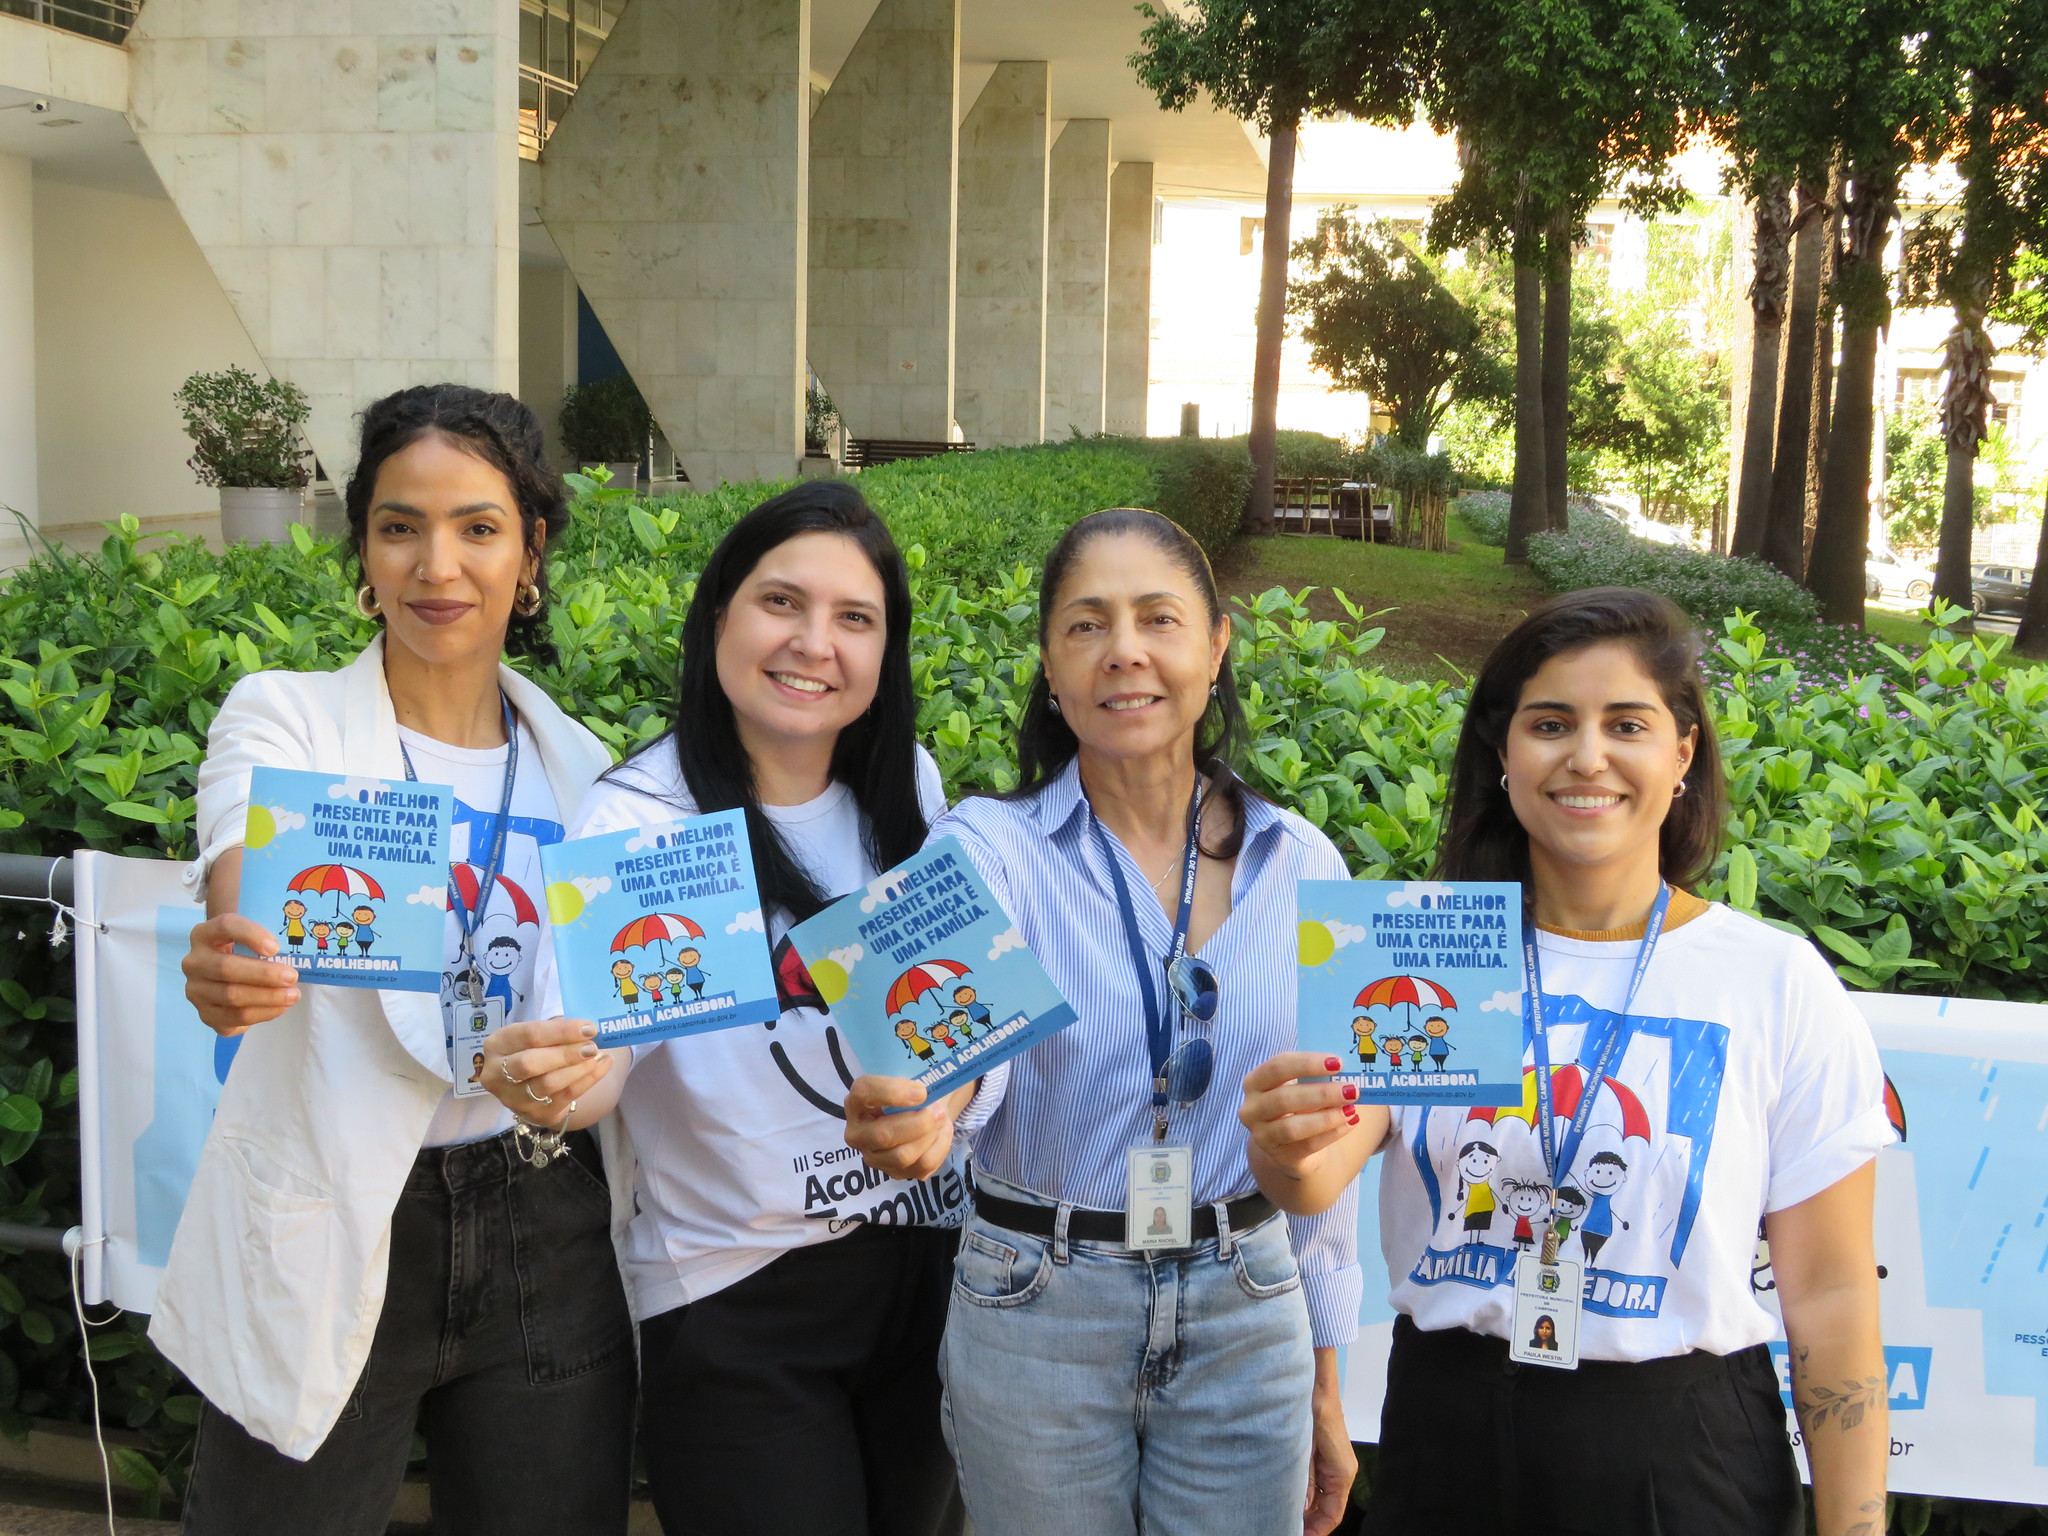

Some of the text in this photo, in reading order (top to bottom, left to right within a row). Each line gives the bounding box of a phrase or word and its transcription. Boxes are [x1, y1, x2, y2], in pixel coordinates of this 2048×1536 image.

[358, 789, 440, 810] O MELHOR
[312, 803, 438, 829] PRESENTE PARA
[314, 822, 438, 846] UMA CRIANÇA É
[656, 822, 734, 850] O MELHOR
[328, 842, 436, 865] UMA FAMÍLIA.
[615, 840, 738, 876] PRESENTE PARA
[1188, 860, 1196, 870] DE
[620, 854, 742, 894] UMA CRIANÇA É
[885, 852, 956, 901] O MELHOR
[1184, 870, 1195, 905] CAMPINAS
[638, 877, 744, 908] UMA FAMÍLIA.
[858, 870, 968, 940] PRESENTE PARA
[1420, 894, 1506, 910] O MELHOR
[870, 884, 979, 955] UMA CRIANÇA É
[1372, 914, 1506, 930] PRESENTE PARA
[1648, 911, 1662, 942] PREFEITURA
[892, 904, 990, 965] UMA FAMÍLIA.
[1376, 930, 1507, 952] UMA CRIANÇA É
[316, 957, 399, 971] ACOLHEDORA
[1392, 949, 1508, 968] UMA FAMÍLIA.
[1638, 942, 1653, 970] MUNICIPAL
[1526, 944, 1542, 1034] PREFEITURA MUNICIPAL CAMPINAS
[600, 996, 736, 1034] FAMÍLIA ACOLHEDORA
[956, 1016, 1030, 1065] ACOLHEDORA
[1391, 1074, 1477, 1086] ACOLHEDORA
[1539, 1066, 1548, 1100] CAMPINAS
[1574, 1030, 1618, 1133] PREFEITURA MUNICIPAL CAMPINAS
[1541, 1101, 1549, 1138] MUNICIPAL
[793, 1155, 809, 1173] III
[2014, 1334, 2048, 1345] PESS
